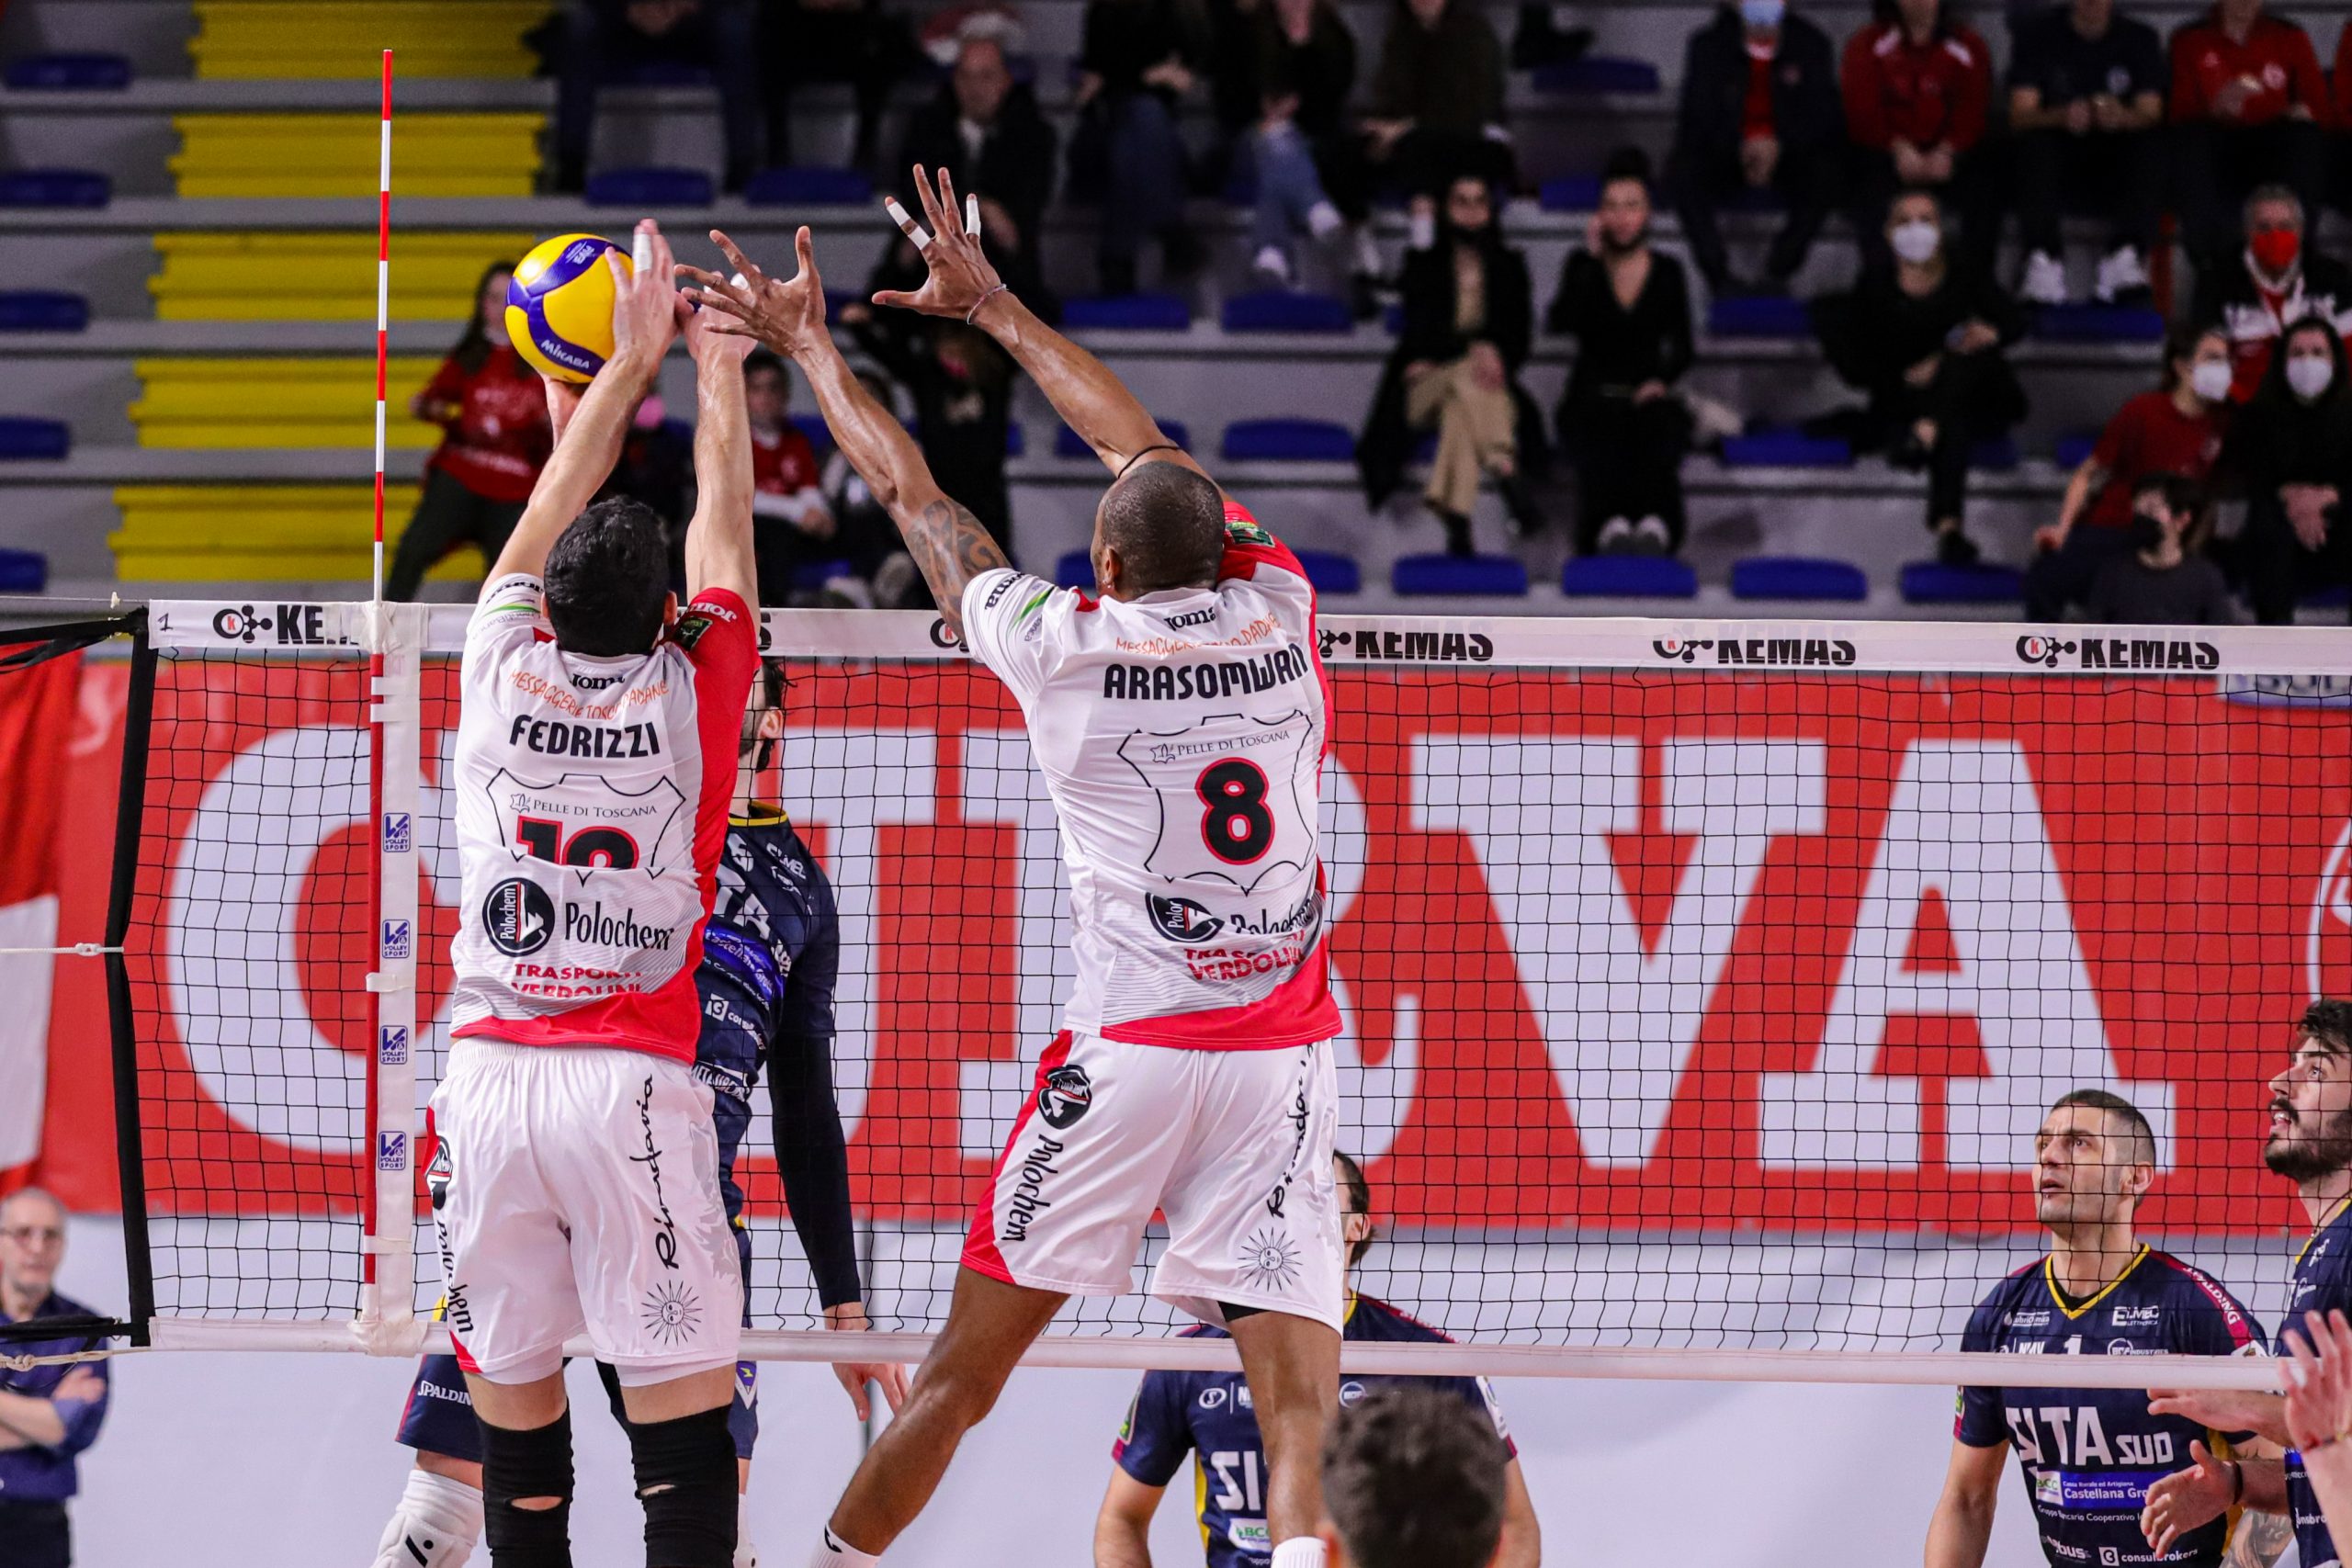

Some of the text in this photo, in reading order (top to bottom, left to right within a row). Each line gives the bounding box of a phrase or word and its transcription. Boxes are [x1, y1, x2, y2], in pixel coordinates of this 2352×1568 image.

[1355, 630, 1494, 661] KEMAS
[1717, 639, 1857, 666] KEMAS
[2081, 637, 2221, 671] KEMAS
[1103, 643, 1308, 700] ARASOMWAN
[509, 715, 661, 759] FEDRIZZI
[1178, 730, 1290, 756] PELLE DI TOSCANA
[533, 799, 658, 818] PELLE DI TOSCANA
[1194, 757, 1276, 866] 8
[500, 887, 517, 941] Polochem
[565, 901, 675, 951] Polochem
[1001, 1134, 1064, 1242] Polochem
[417, 1380, 471, 1405] SPALDIN
[2115, 1431, 2175, 1464] SUD
[2064, 1488, 2125, 1499] Castellana
[2086, 1513, 2136, 1523] Cooperativo
